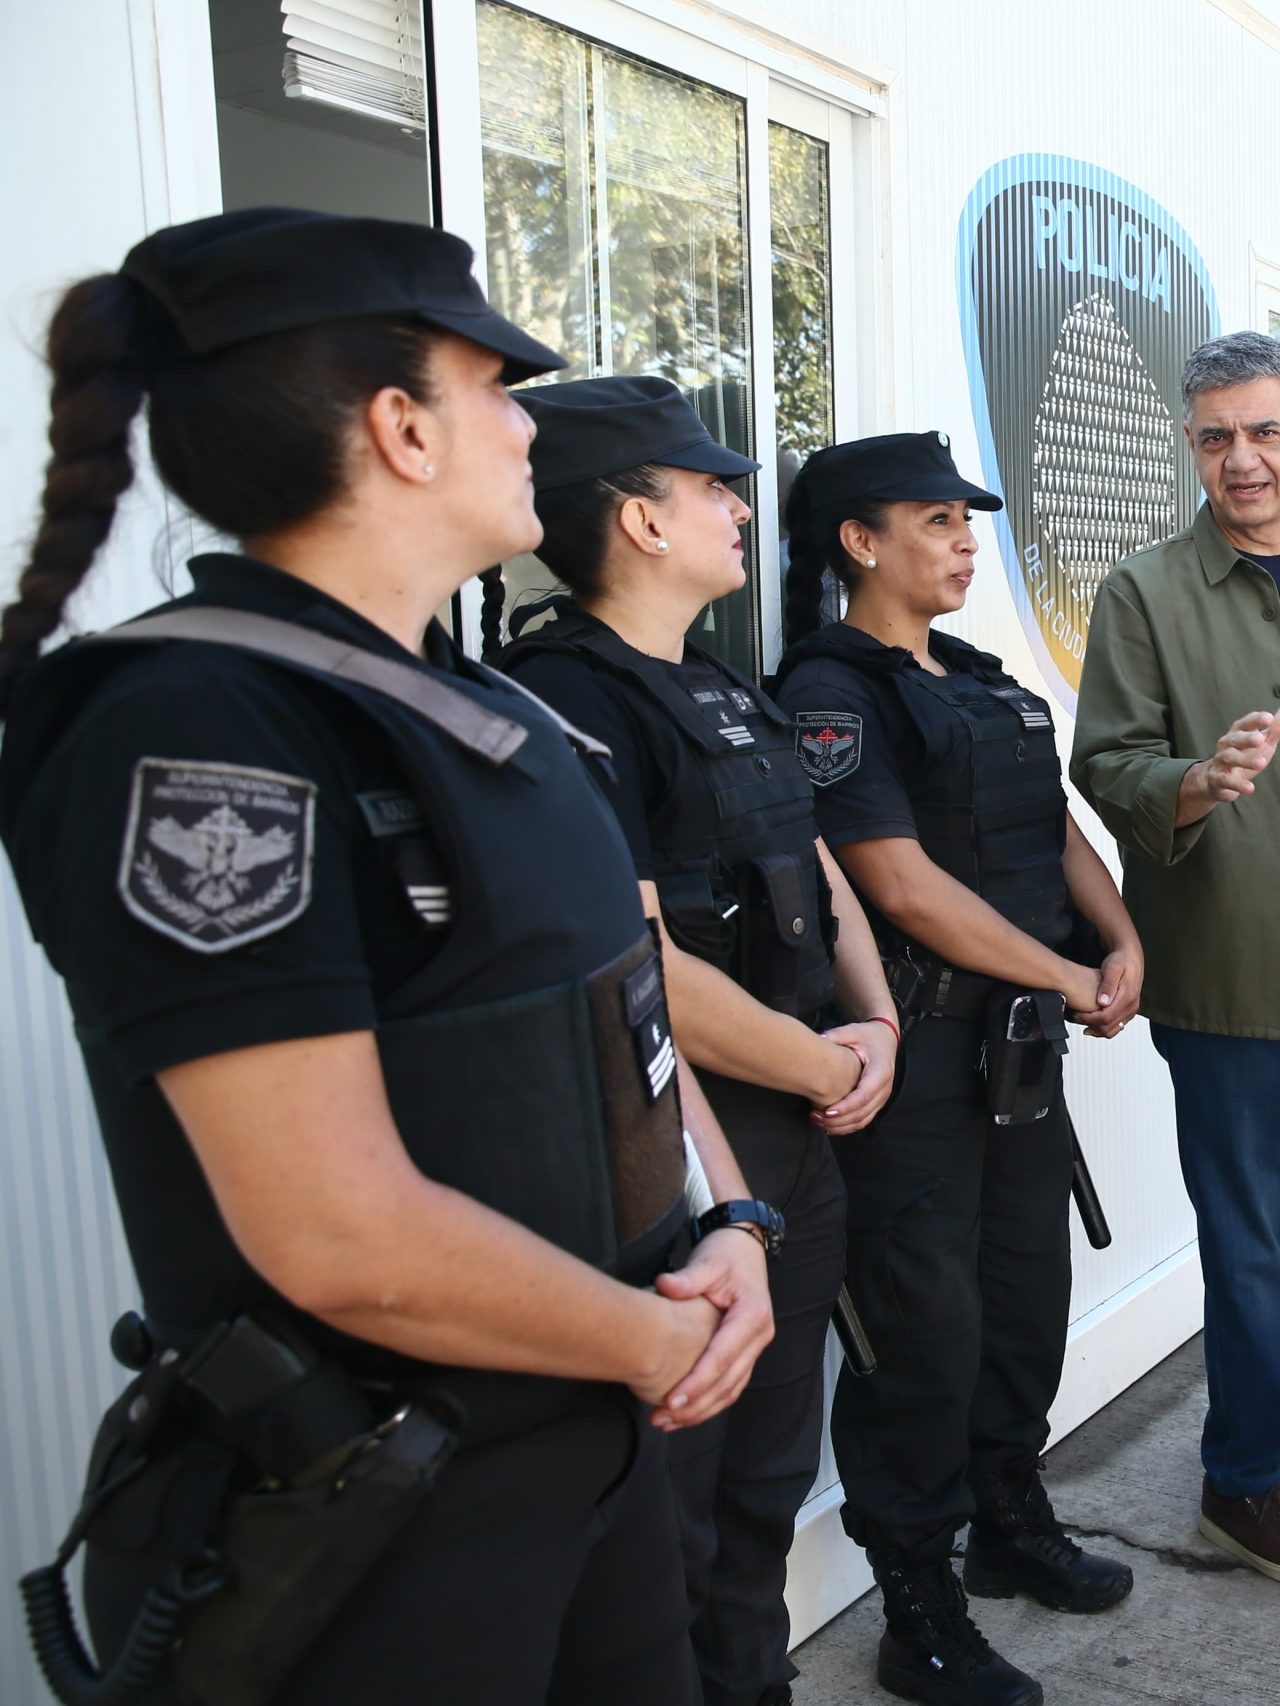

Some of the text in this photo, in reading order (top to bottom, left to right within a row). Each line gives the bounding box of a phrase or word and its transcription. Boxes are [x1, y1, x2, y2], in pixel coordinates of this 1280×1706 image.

[1024, 543, 1044, 582] DE
[1035, 579, 1055, 620] LA
[167, 771, 290, 797] SUPERINTENDENCIA
[232, 790, 247, 805] DE
[252, 794, 300, 816] BARRIOS
